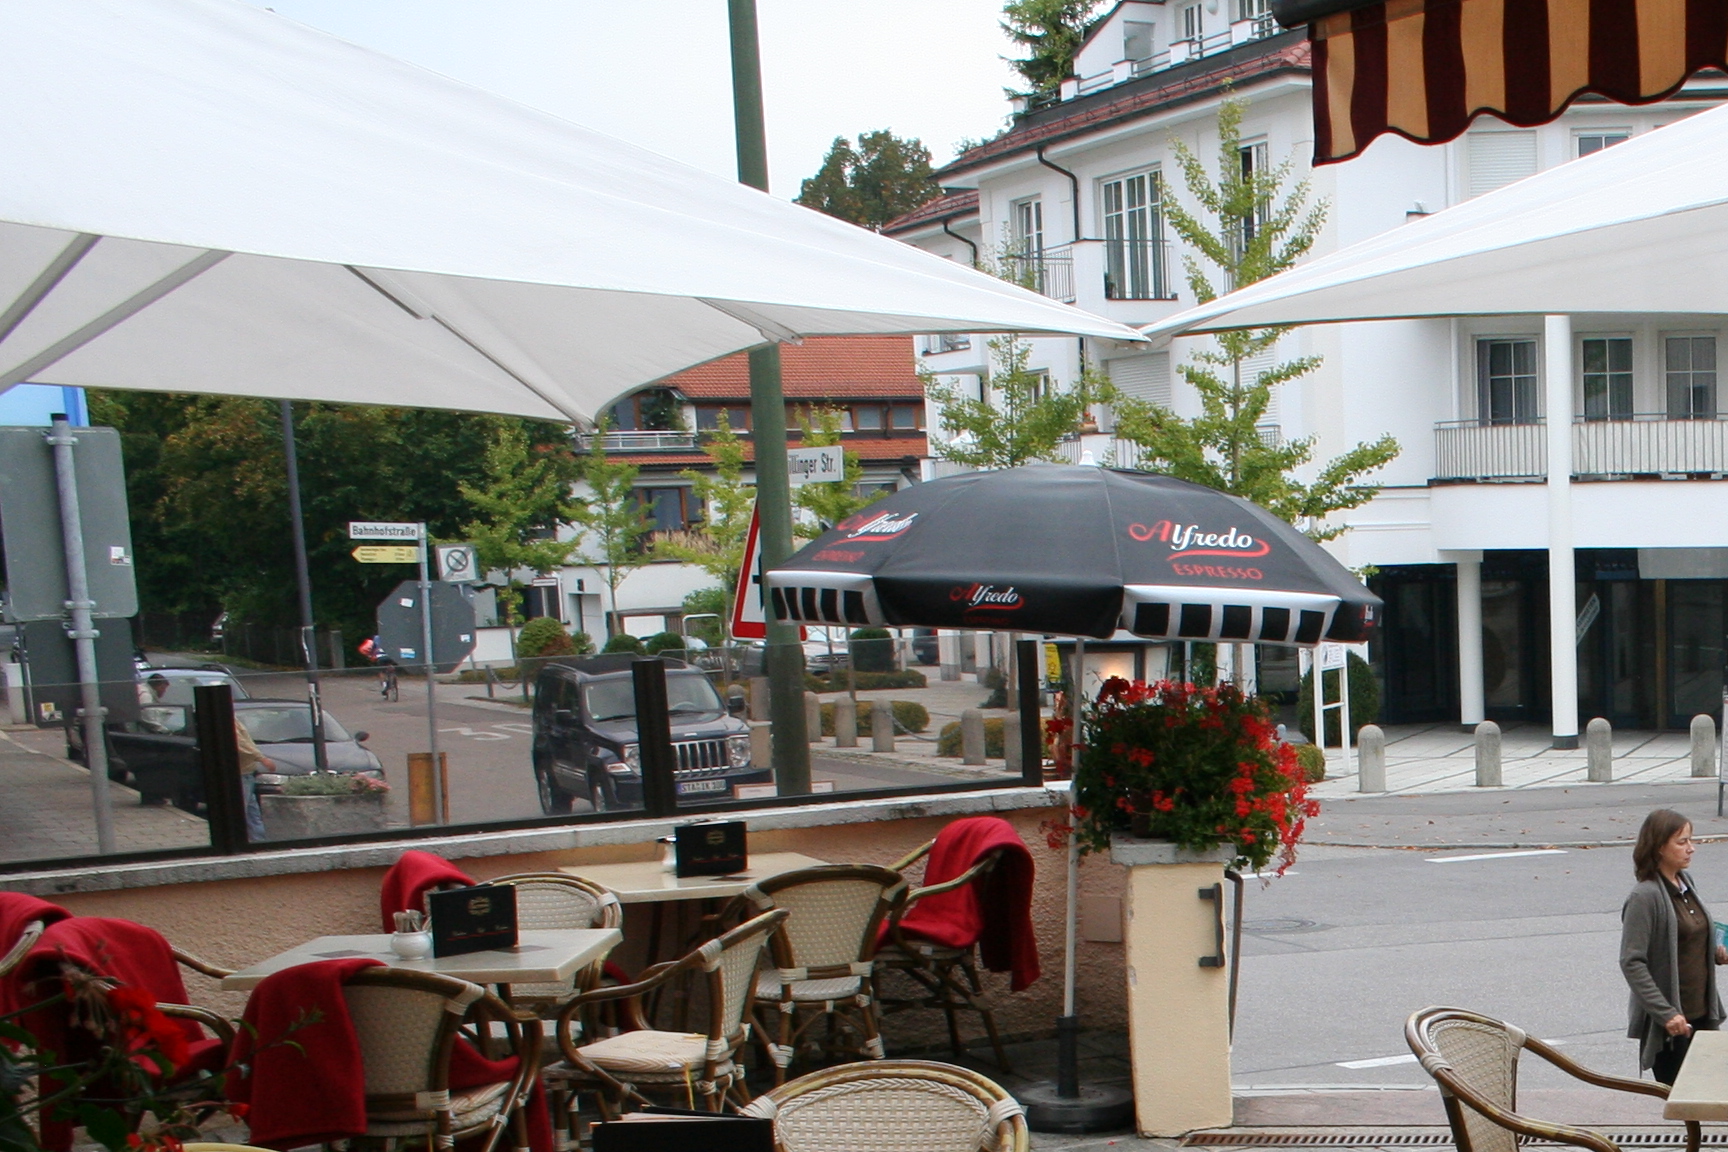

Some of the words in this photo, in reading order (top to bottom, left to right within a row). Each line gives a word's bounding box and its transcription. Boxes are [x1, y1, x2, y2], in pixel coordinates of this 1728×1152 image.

[821, 453, 836, 473] Str.
[352, 525, 416, 536] Bahnhofstraße
[1128, 519, 1253, 550] Alfredo
[1171, 563, 1263, 580] ESPRESSO
[949, 582, 1019, 606] Alfredo
